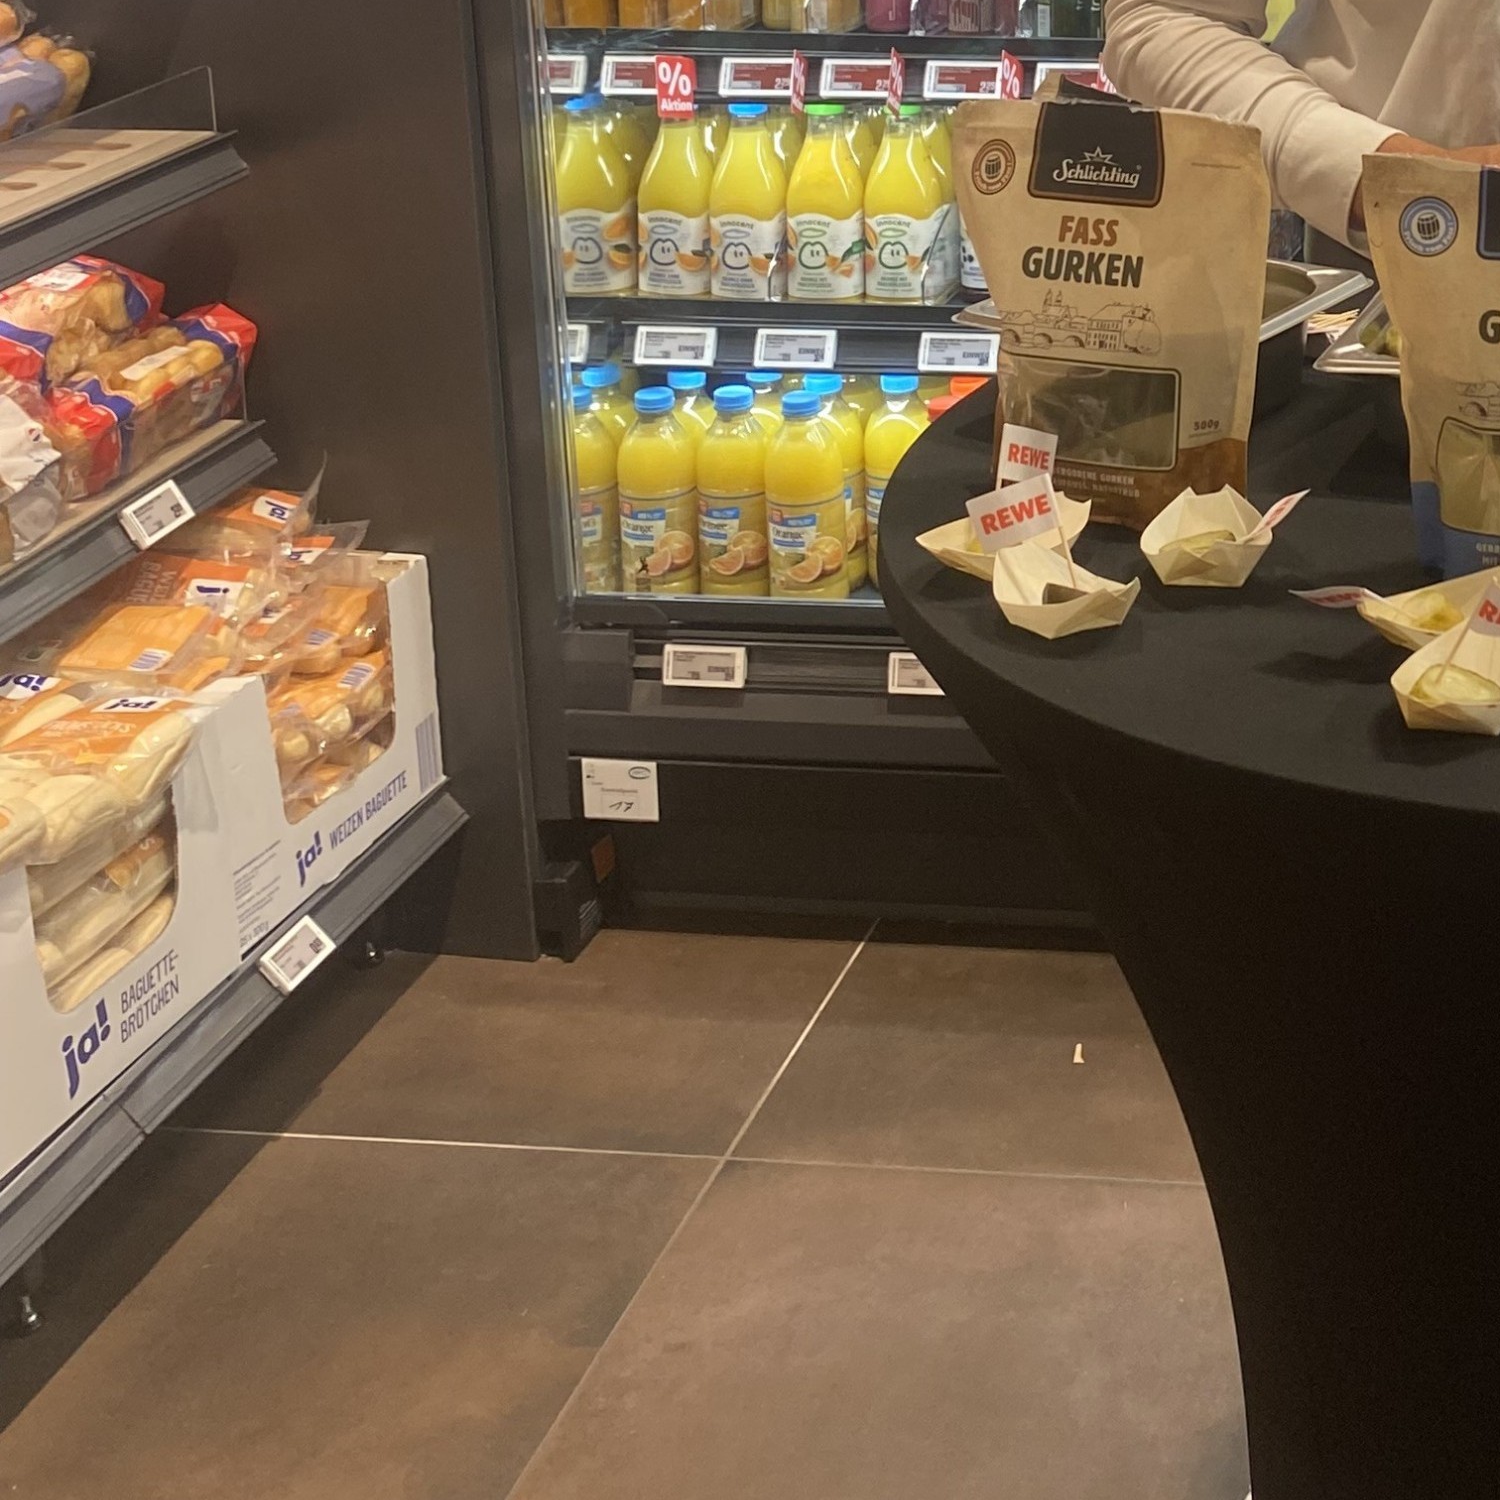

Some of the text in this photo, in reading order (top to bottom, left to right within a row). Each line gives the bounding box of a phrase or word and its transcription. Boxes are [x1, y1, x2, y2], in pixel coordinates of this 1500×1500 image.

[660, 99, 694, 112] Aktion
[1052, 156, 1141, 188] Schlichting
[1058, 214, 1119, 247] FASS
[1021, 246, 1144, 289] GURKEN
[1007, 442, 1051, 470] REWE
[979, 492, 1054, 537] REWE
[296, 769, 408, 889] ja! WEIZEN BAGUETTE
[120, 948, 180, 1016] BAGUETTE-
[120, 973, 180, 1044] BRÖTCHEN
[61, 996, 112, 1101] ja!
